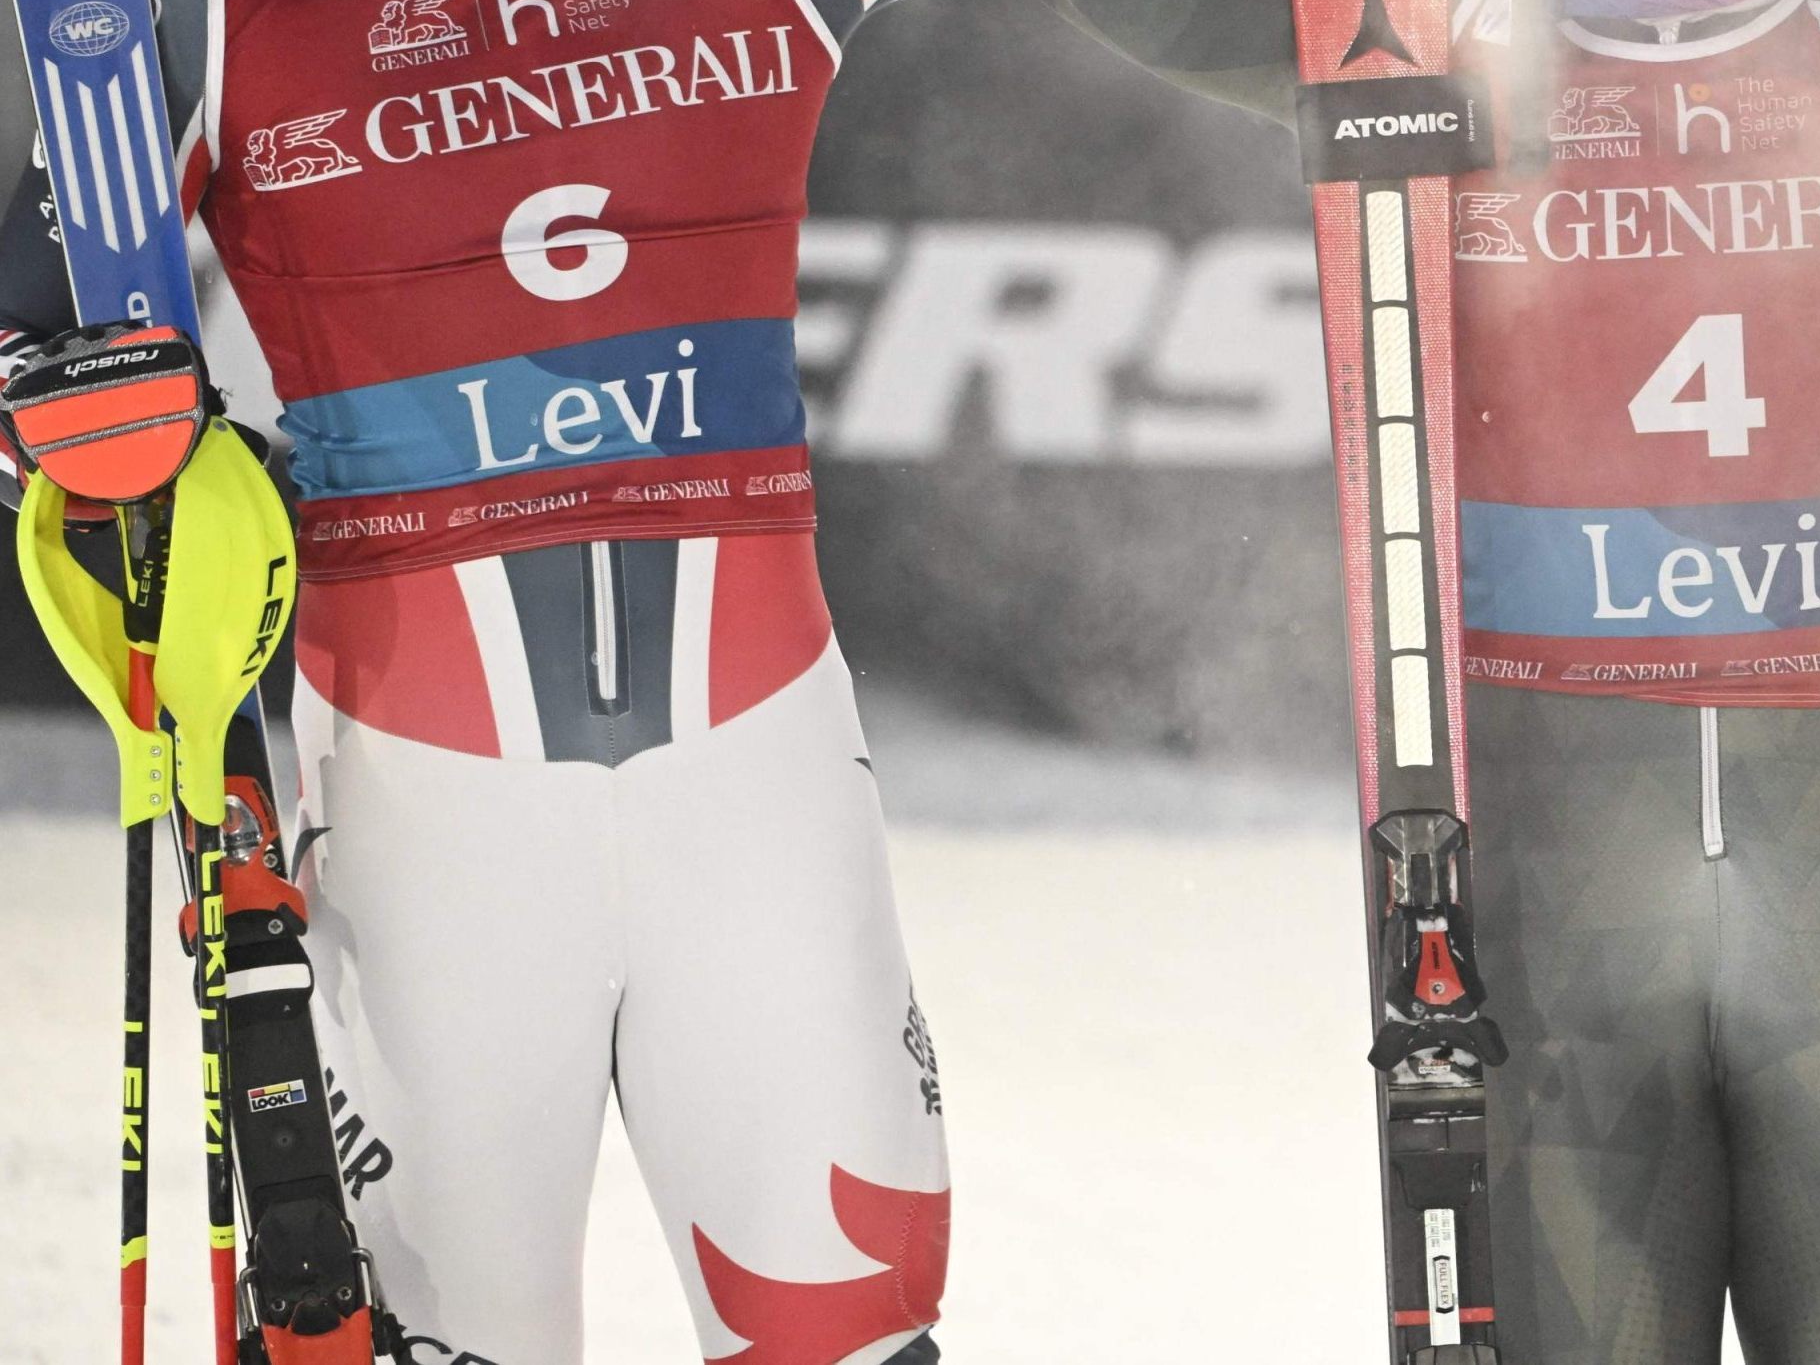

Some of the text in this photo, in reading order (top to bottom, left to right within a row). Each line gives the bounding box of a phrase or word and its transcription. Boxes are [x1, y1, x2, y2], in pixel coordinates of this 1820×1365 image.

[65, 17, 114, 40] WC
[567, 14, 610, 34] Net
[372, 41, 470, 72] GENERALI
[364, 27, 800, 164] GENERALI
[1735, 77, 1774, 94] The
[1737, 94, 1812, 114] Human
[1334, 112, 1459, 140] ATOMIC
[1739, 113, 1806, 133] Safety
[1742, 136, 1780, 152] Net
[501, 184, 627, 301] 6
[64, 348, 158, 377] reusch
[1627, 313, 1767, 458] 4
[458, 338, 703, 471] Levi
[332, 512, 427, 540] GENERALI
[481, 491, 589, 520] GENERALI
[645, 478, 729, 502] GENERALI
[138, 559, 154, 607] LEKI
[240, 555, 287, 677] LEKI
[1593, 662, 1697, 682] GENERALI
[202, 849, 228, 997] LEKI
[251, 1092, 291, 1111] LOOK
[1439, 1262, 1449, 1305] FULL FLEX
